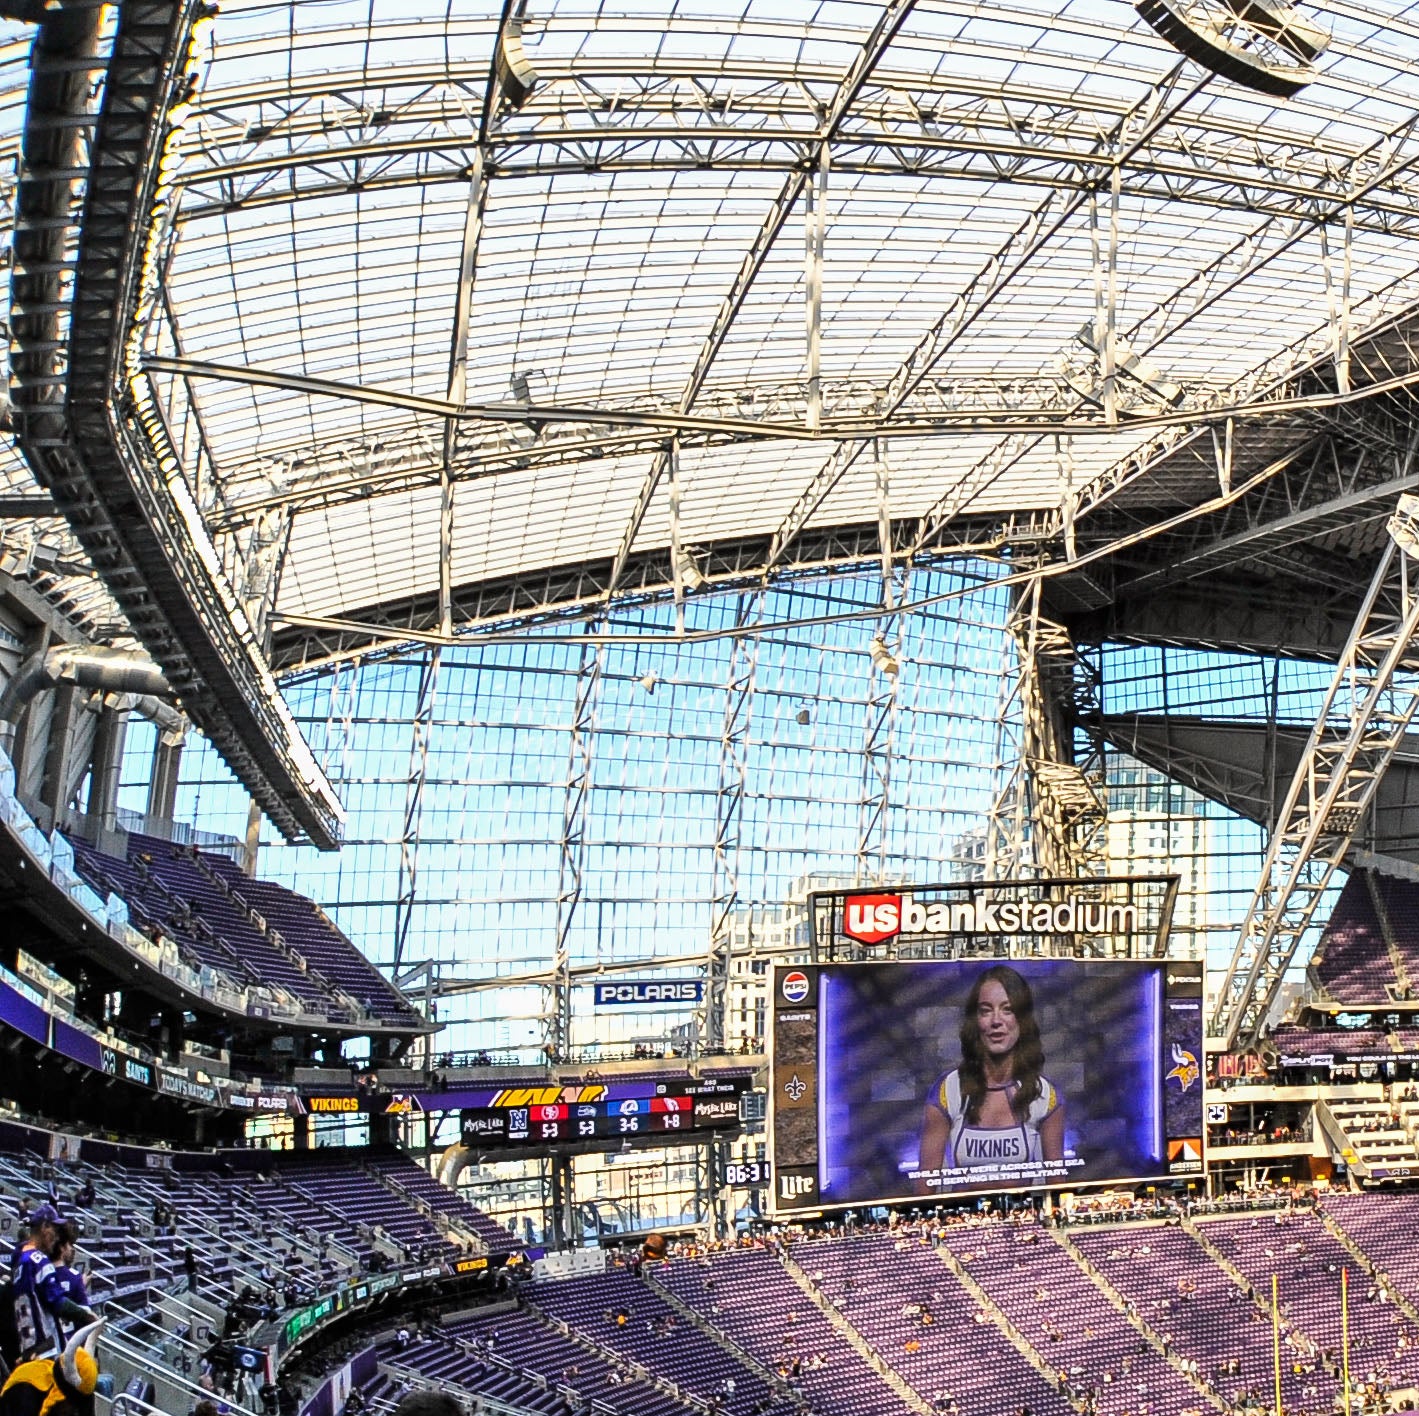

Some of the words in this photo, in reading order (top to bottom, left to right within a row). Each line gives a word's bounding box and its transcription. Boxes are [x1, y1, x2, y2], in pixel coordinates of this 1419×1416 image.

[600, 983, 697, 1001] POLARIS
[785, 982, 806, 990] PEPSI
[310, 1097, 359, 1112] VIKINGS
[662, 1113, 681, 1129] 1-8
[1208, 1105, 1227, 1122] 25
[542, 1122, 558, 1138] 5-3
[579, 1120, 595, 1136] 5-3
[620, 1116, 639, 1132] 3-6
[966, 1138, 1020, 1158] VIKINGS
[726, 1163, 771, 1185] 86:31
[941, 1167, 968, 1177] THEY
[969, 1165, 999, 1174] WERE
[1000, 1161, 1042, 1172] ACROSS
[1043, 1160, 1063, 1168] THE
[779, 1173, 813, 1198] Lite
[943, 1175, 987, 1185] SERVING
[999, 1171, 1020, 1180] THE
